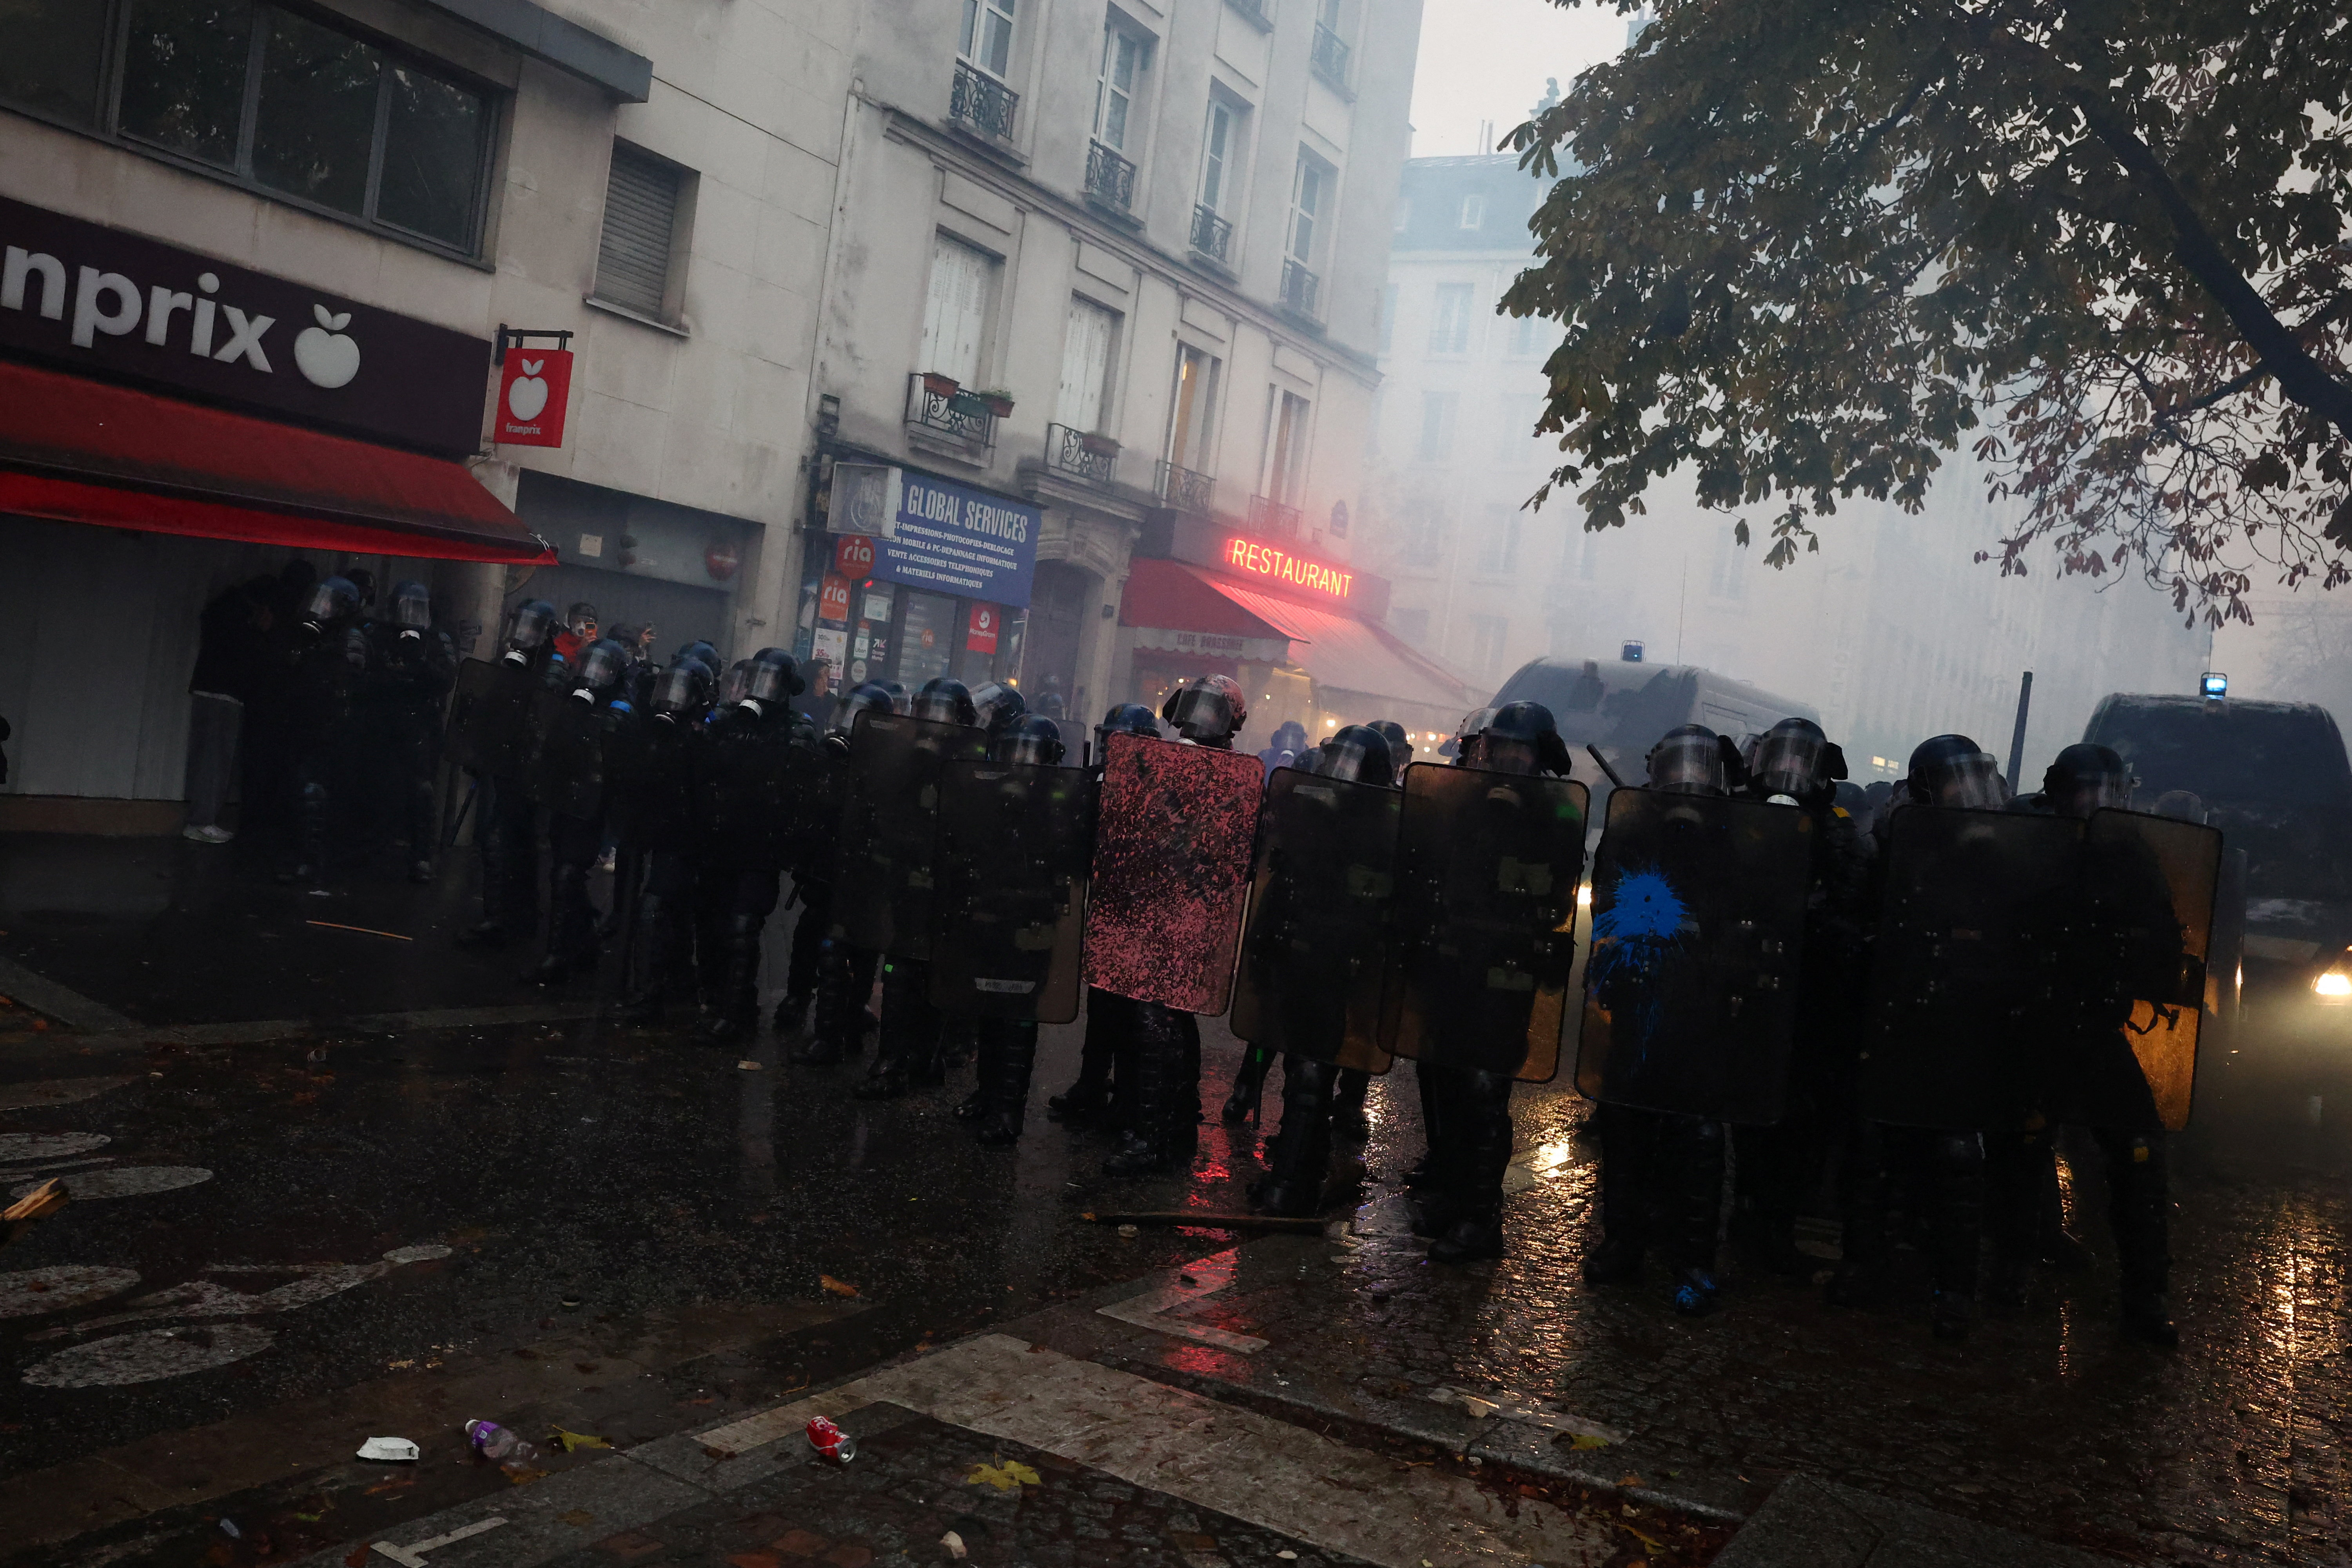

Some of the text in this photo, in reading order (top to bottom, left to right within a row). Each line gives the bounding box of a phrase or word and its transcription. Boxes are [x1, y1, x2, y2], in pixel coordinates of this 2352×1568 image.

[0, 245, 276, 373] nprix
[506, 423, 541, 435] franprix
[907, 485, 960, 526] GLOBAL
[965, 501, 1028, 543] SERVICES
[844, 539, 871, 562] ria
[902, 537, 926, 549] MOBILE
[976, 554, 1017, 570] INFORMATIQUE
[888, 549, 994, 577] VENTE ACCESSOIRES TELEPHONIQUES
[1232, 540, 1352, 597] RESTAURANT
[902, 566, 935, 579] MATERIELS
[936, 573, 983, 588] INFORMATIQUES
[824, 580, 847, 604] ria
[922, 631, 933, 642] ria
[969, 628, 996, 638] MoneyGram
